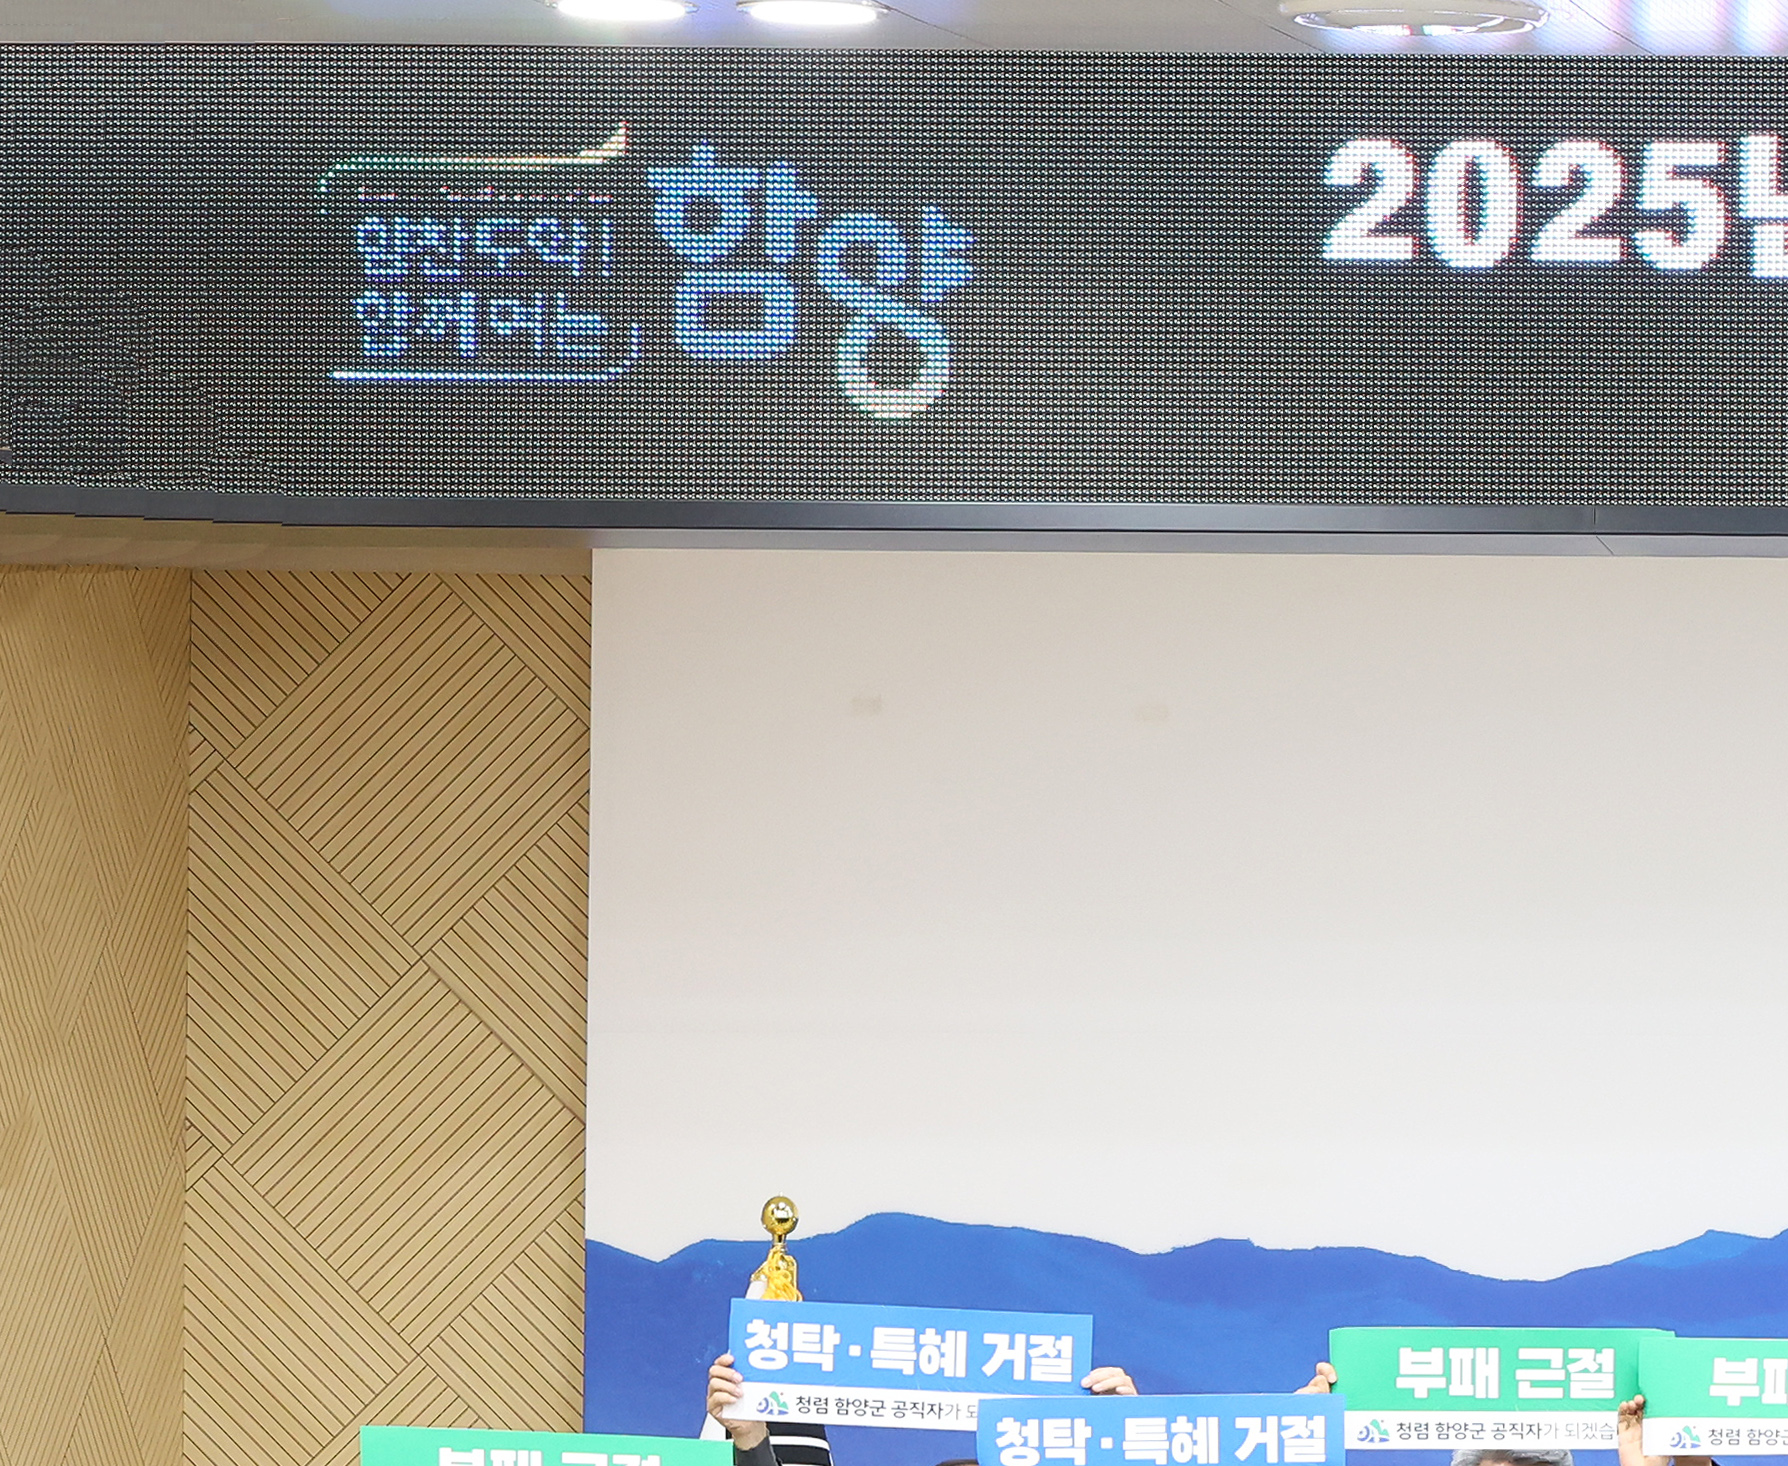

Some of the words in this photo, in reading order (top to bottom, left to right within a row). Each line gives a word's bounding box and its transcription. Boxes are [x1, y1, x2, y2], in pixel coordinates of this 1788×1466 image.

[647, 141, 975, 420] 함양
[982, 1332, 1074, 1384] 거절
[1395, 1347, 1500, 1399] 부패
[1515, 1347, 1616, 1399] 근절
[795, 1394, 829, 1415] 청렴
[834, 1396, 887, 1418] 함양군
[891, 1399, 960, 1422] 공직자가
[1235, 1415, 1326, 1464] 거절
